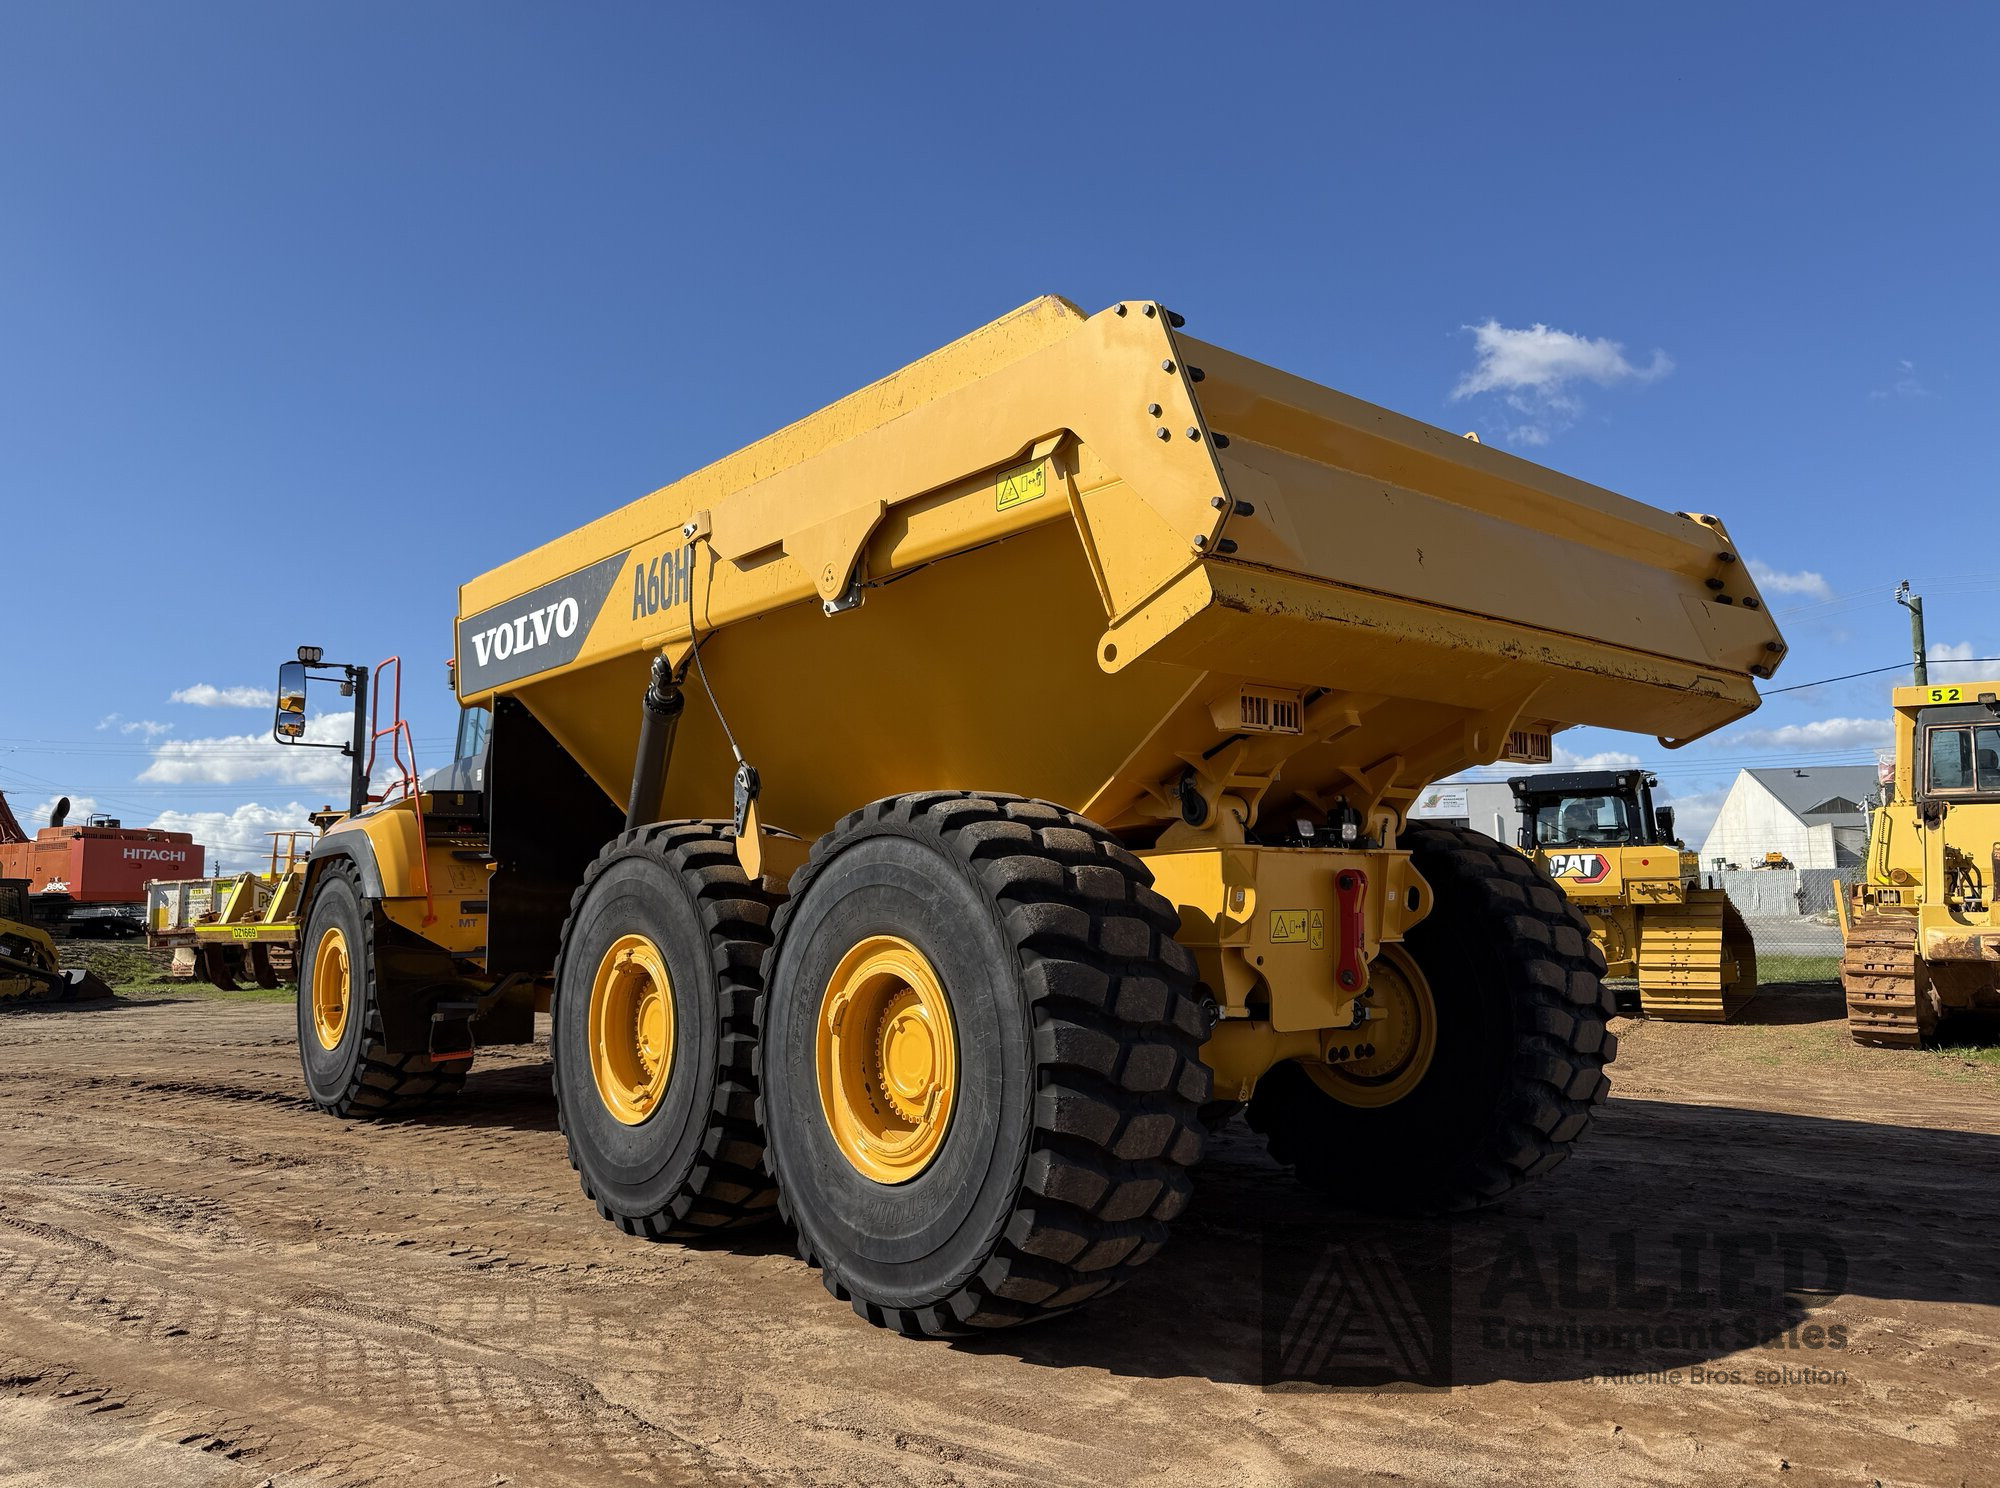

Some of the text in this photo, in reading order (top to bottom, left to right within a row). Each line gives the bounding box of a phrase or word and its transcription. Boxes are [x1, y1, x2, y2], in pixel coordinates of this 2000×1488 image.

[632, 544, 689, 621] A60H
[471, 597, 579, 667] VOLVO
[1932, 689, 1960, 702] 52
[123, 848, 186, 862] HITACHI
[1550, 855, 1597, 878] CAT
[233, 927, 256, 938] DZ1669
